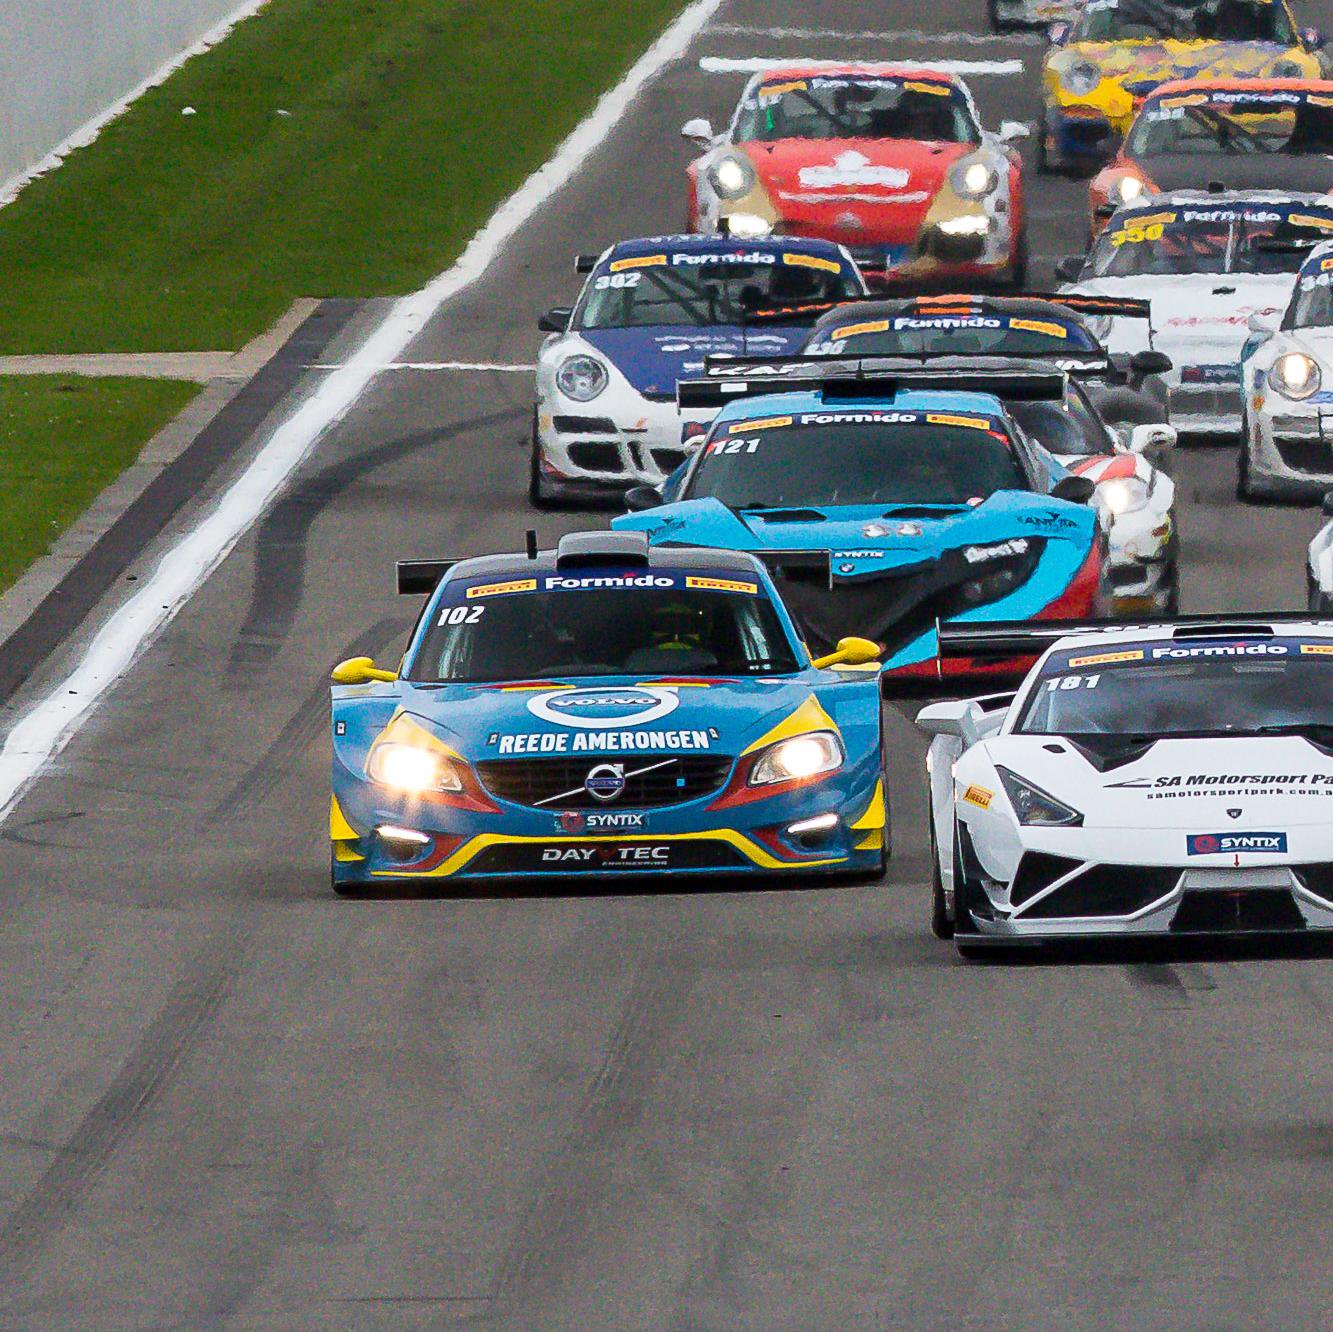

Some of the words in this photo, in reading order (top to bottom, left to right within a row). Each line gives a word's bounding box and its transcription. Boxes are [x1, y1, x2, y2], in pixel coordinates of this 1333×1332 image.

[672, 251, 776, 266] Formido
[801, 412, 917, 425] Formido
[711, 438, 761, 455] 121
[545, 574, 674, 590] Formido
[436, 605, 486, 627] 102
[1153, 643, 1289, 658] Formido
[1046, 675, 1101, 692] 181
[550, 698, 659, 706] VOLVO
[499, 733, 569, 754] REEDE
[572, 730, 710, 752] AMERONGEN
[1155, 776, 1182, 788] SA
[1186, 774, 1308, 786] Motorsport
[586, 814, 643, 826] SYNTIX
[1220, 837, 1281, 848] SYNTIX
[542, 848, 597, 861] DAY
[617, 846, 670, 860] TEC
